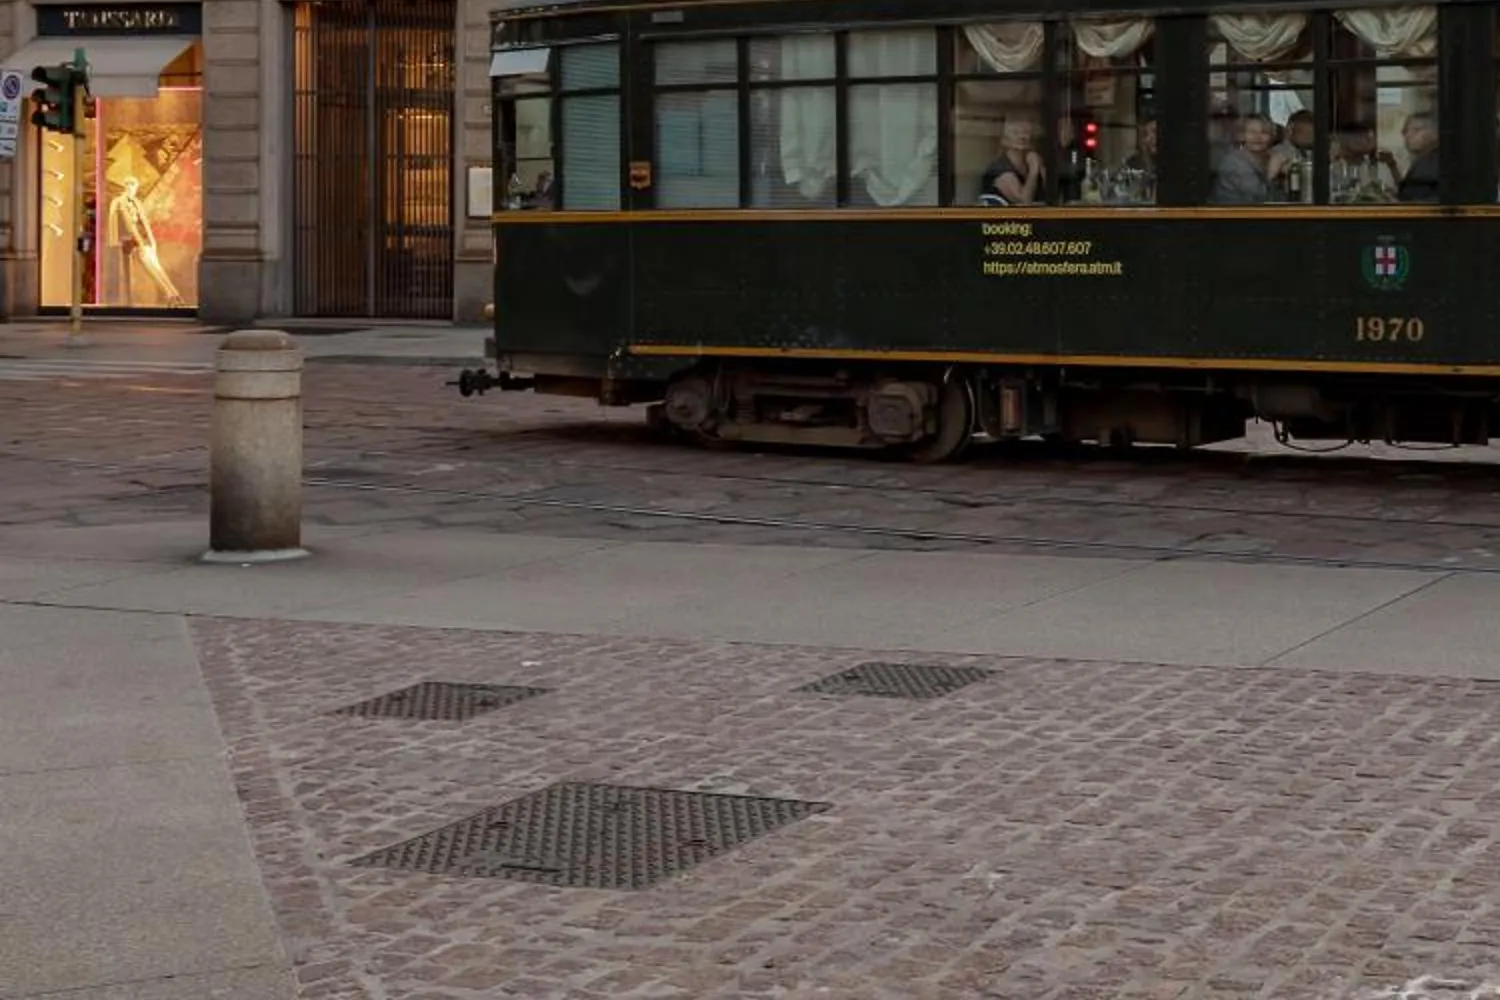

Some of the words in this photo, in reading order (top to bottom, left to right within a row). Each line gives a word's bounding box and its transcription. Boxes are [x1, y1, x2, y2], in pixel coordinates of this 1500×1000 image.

[981, 221, 1033, 237] booking:
[983, 260, 1123, 276] https://atmosfera.atm.it
[1355, 315, 1425, 343] 1970
